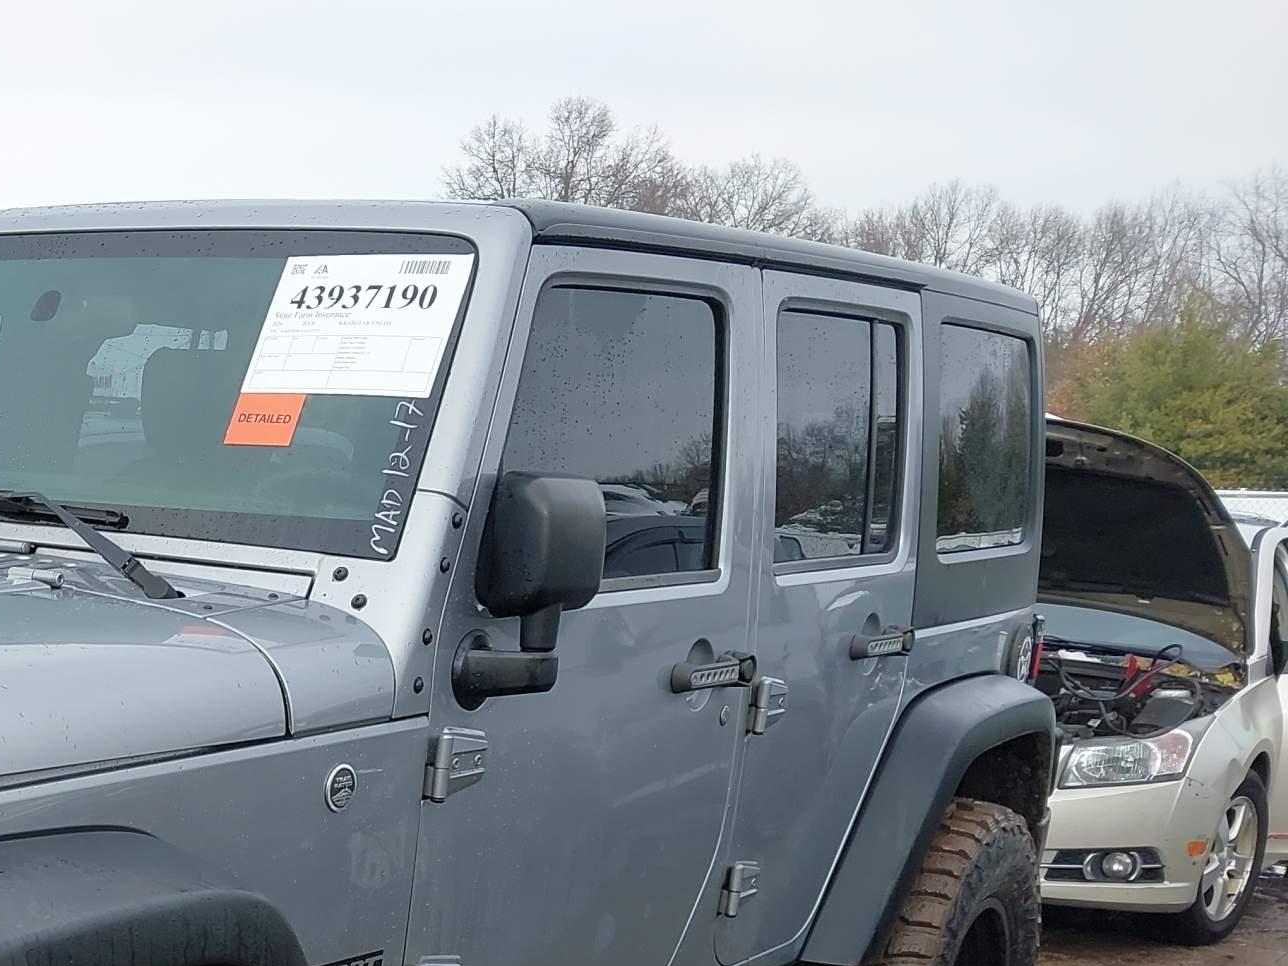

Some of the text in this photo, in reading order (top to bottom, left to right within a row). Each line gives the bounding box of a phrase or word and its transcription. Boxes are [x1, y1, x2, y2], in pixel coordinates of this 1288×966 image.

[289, 284, 438, 310] 43937190
[237, 413, 292, 424] DETAILED
[370, 400, 424, 555] MAD 12-17
